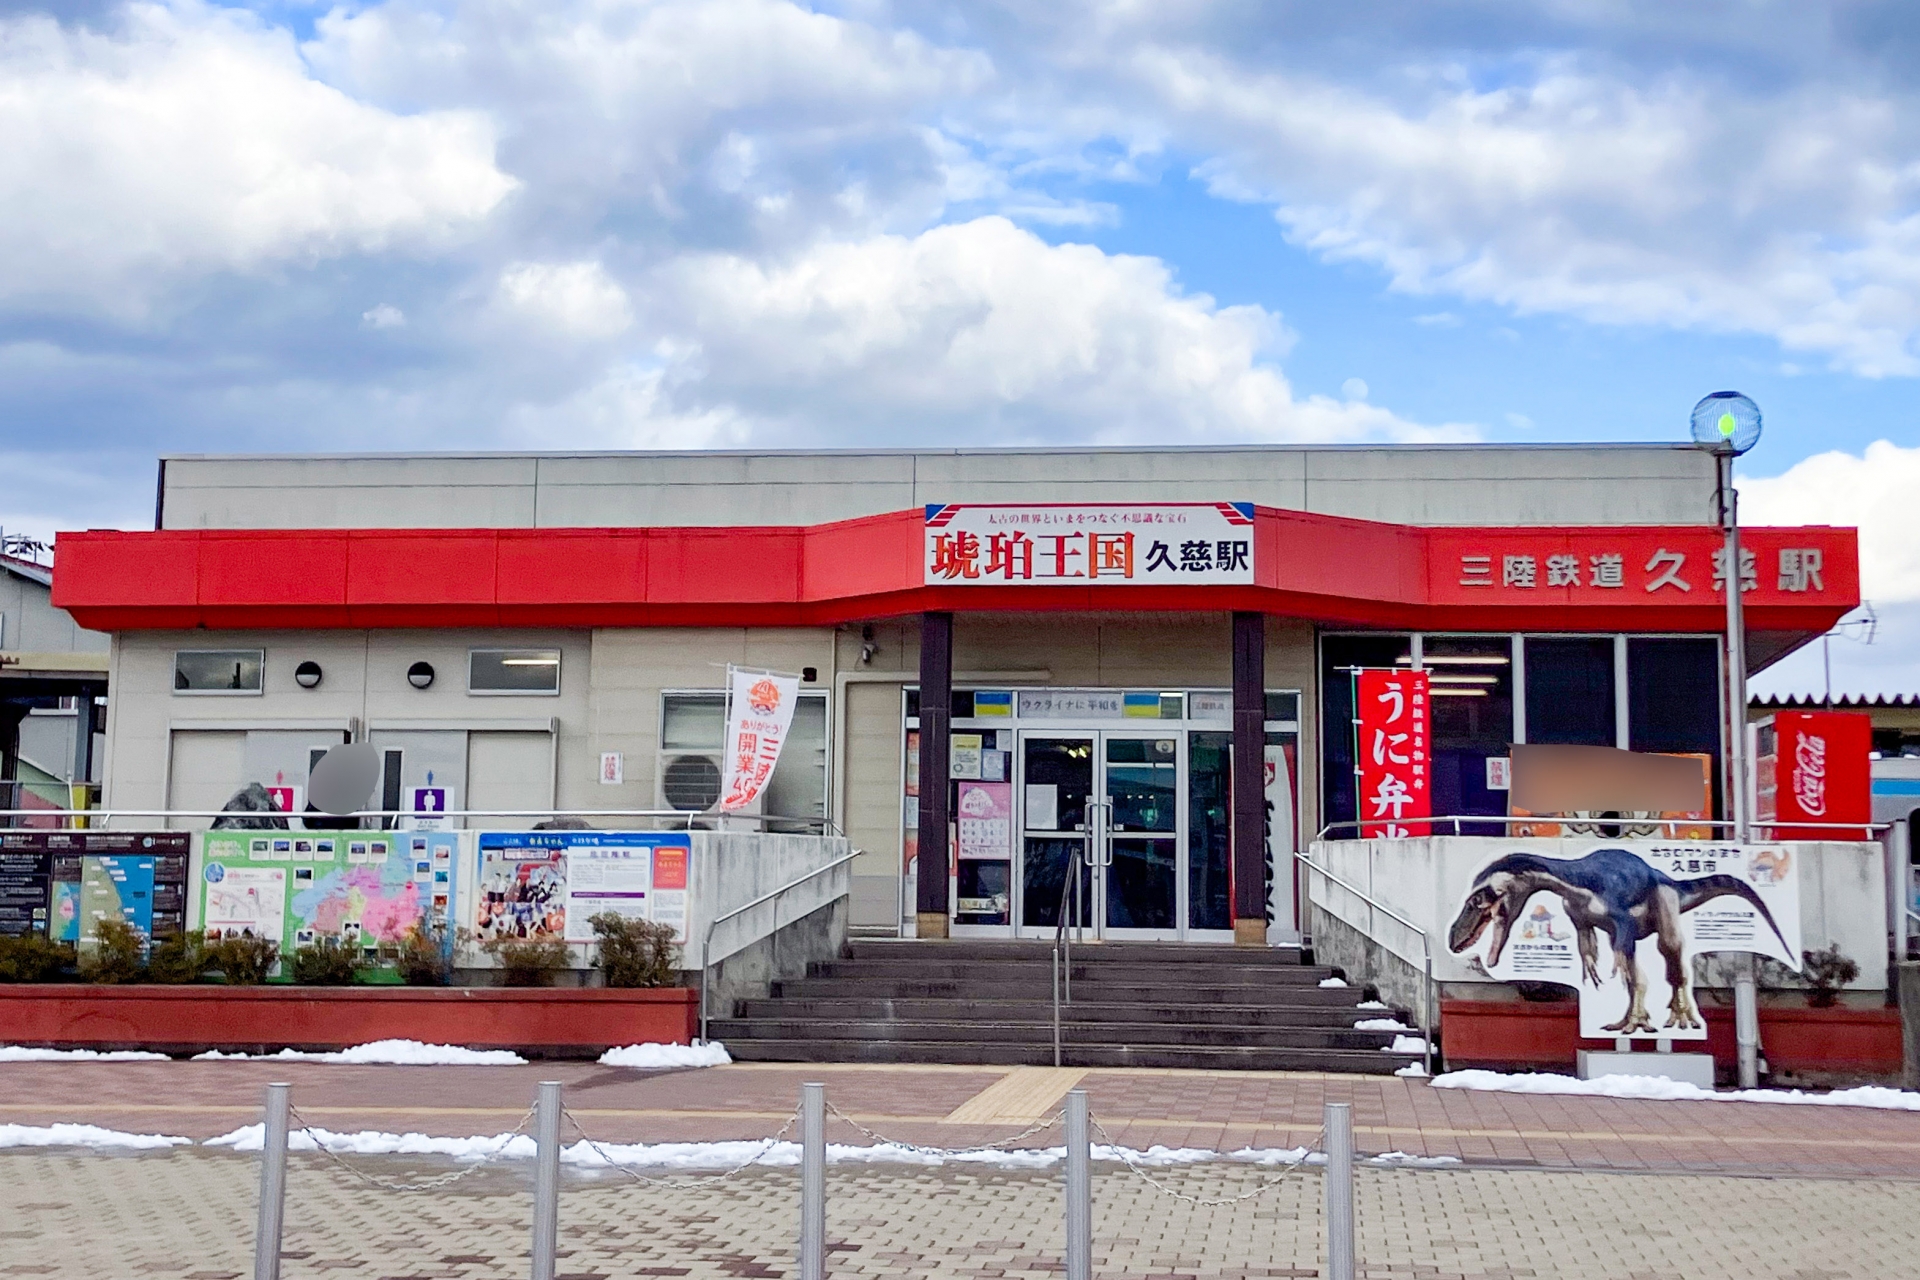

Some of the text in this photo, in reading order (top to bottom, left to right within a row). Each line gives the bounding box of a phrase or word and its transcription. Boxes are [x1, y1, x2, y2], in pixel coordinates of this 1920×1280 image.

[988, 512, 1187, 524] 太古の世界といまをつなぐ不思議な宝石
[931, 531, 1249, 580] 琥珀王国 久慈駅
[1460, 548, 1823, 592] 三陸鉄道 久慈駅
[1796, 730, 1825, 816] Coca-Cola
[1672, 860, 1716, 873] 久慈市
